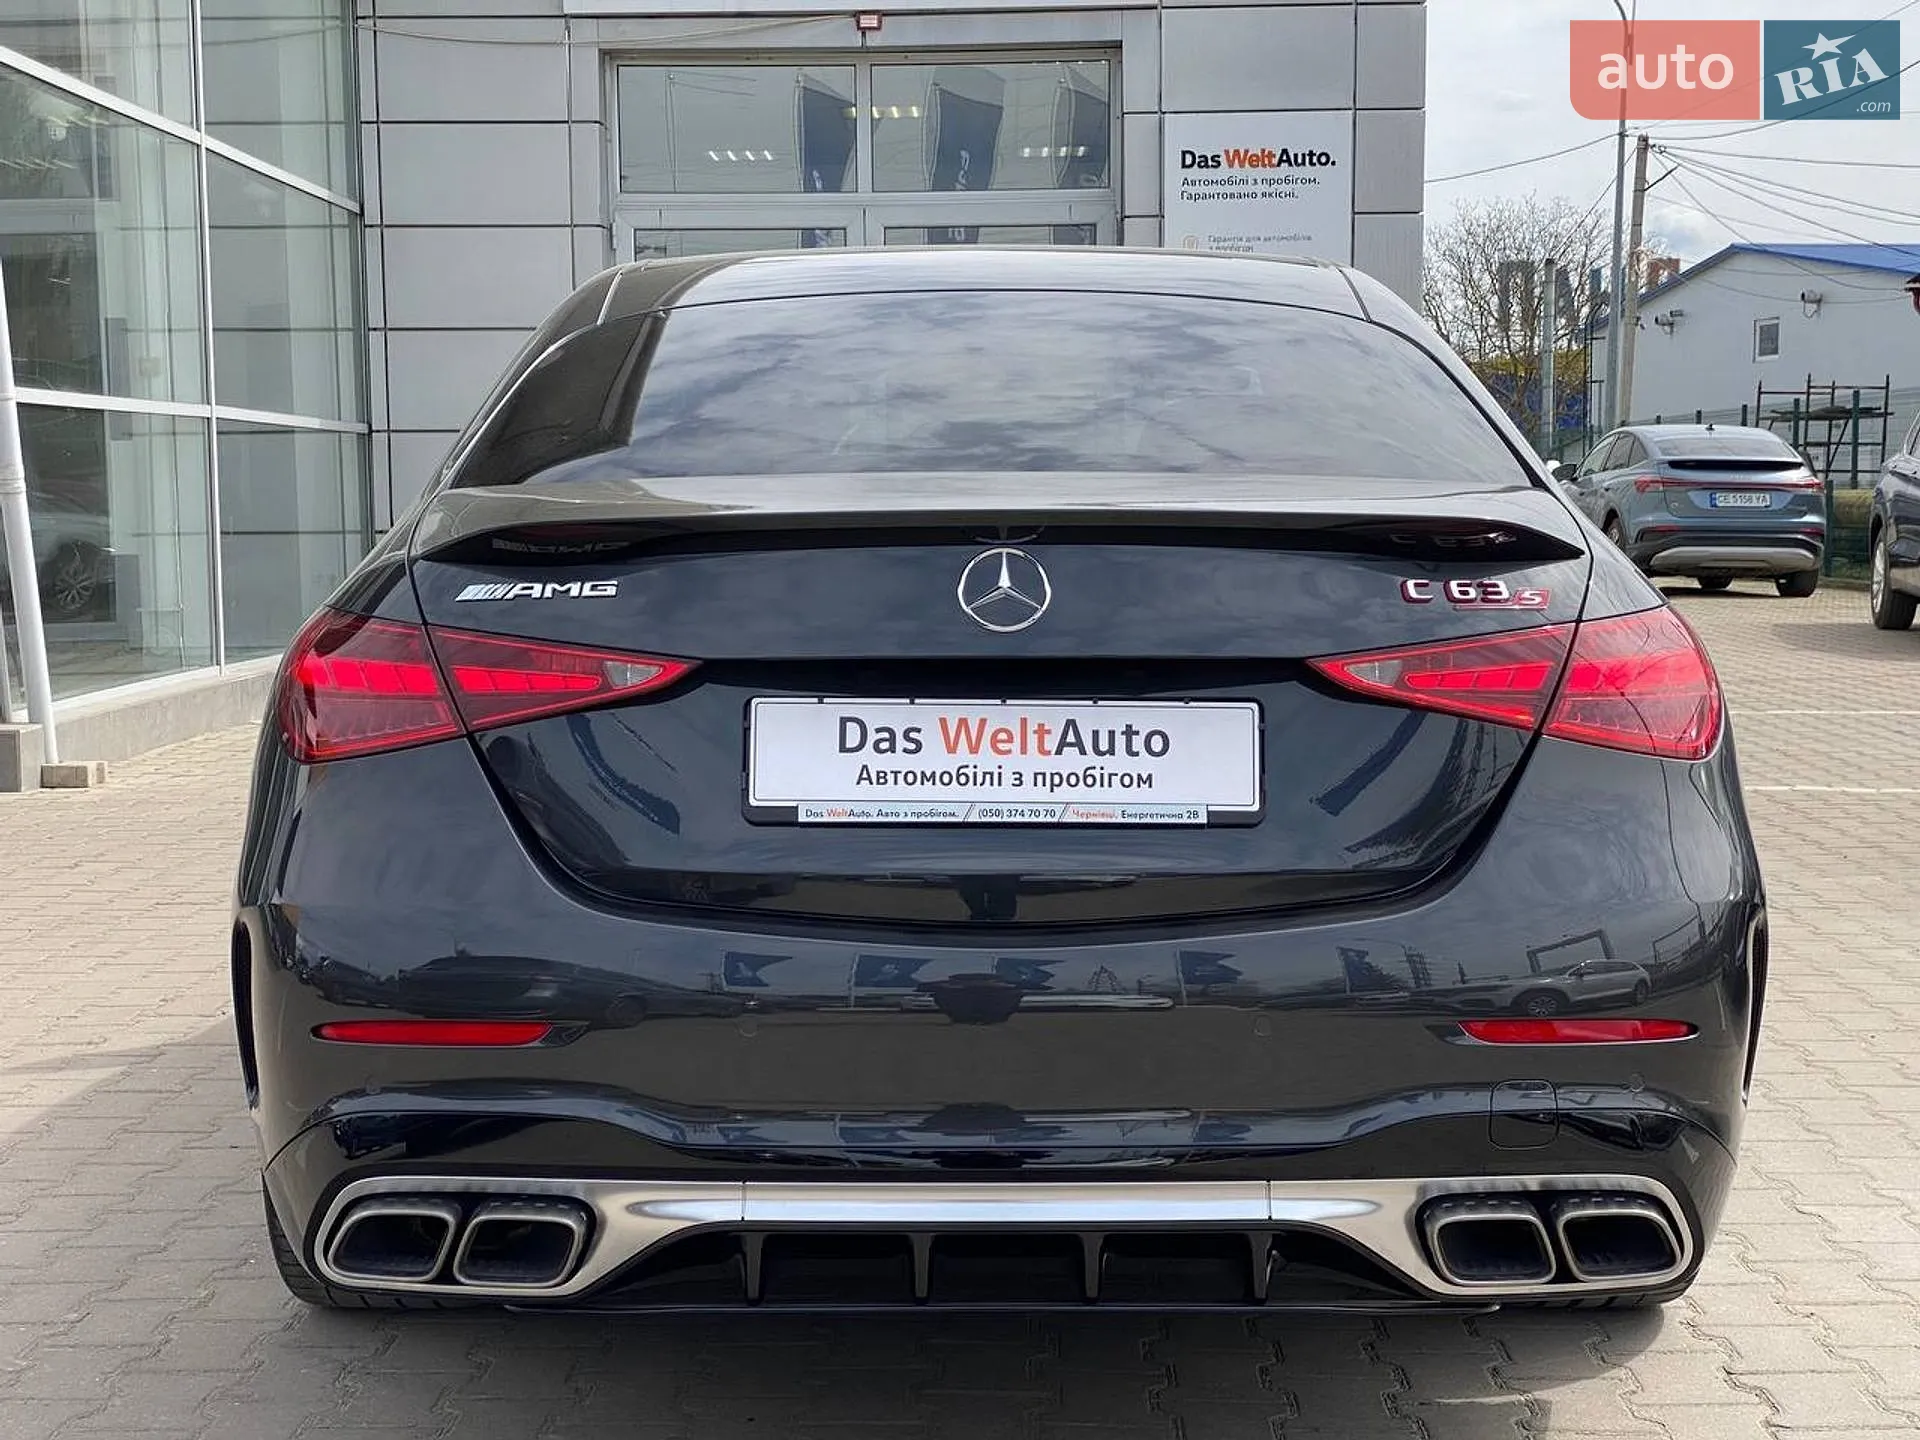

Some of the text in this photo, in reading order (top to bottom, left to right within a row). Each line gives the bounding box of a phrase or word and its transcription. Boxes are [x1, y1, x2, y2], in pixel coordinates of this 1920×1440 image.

[1180, 148, 1336, 169] Das WeltAuto.
[1181, 175, 1320, 189] Автомобілі з пробігом.
[1180, 189, 1299, 202] Гарантовано якісні.
[503, 580, 618, 600] AMG
[1400, 579, 1433, 604] C
[838, 716, 1172, 758] Das WeltAuto
[855, 764, 1154, 792] Автомобілі з пробігом
[805, 808, 824, 818] Das
[876, 808, 900, 818] Авто
[977, 808, 1056, 820] (050) 374 70 70
